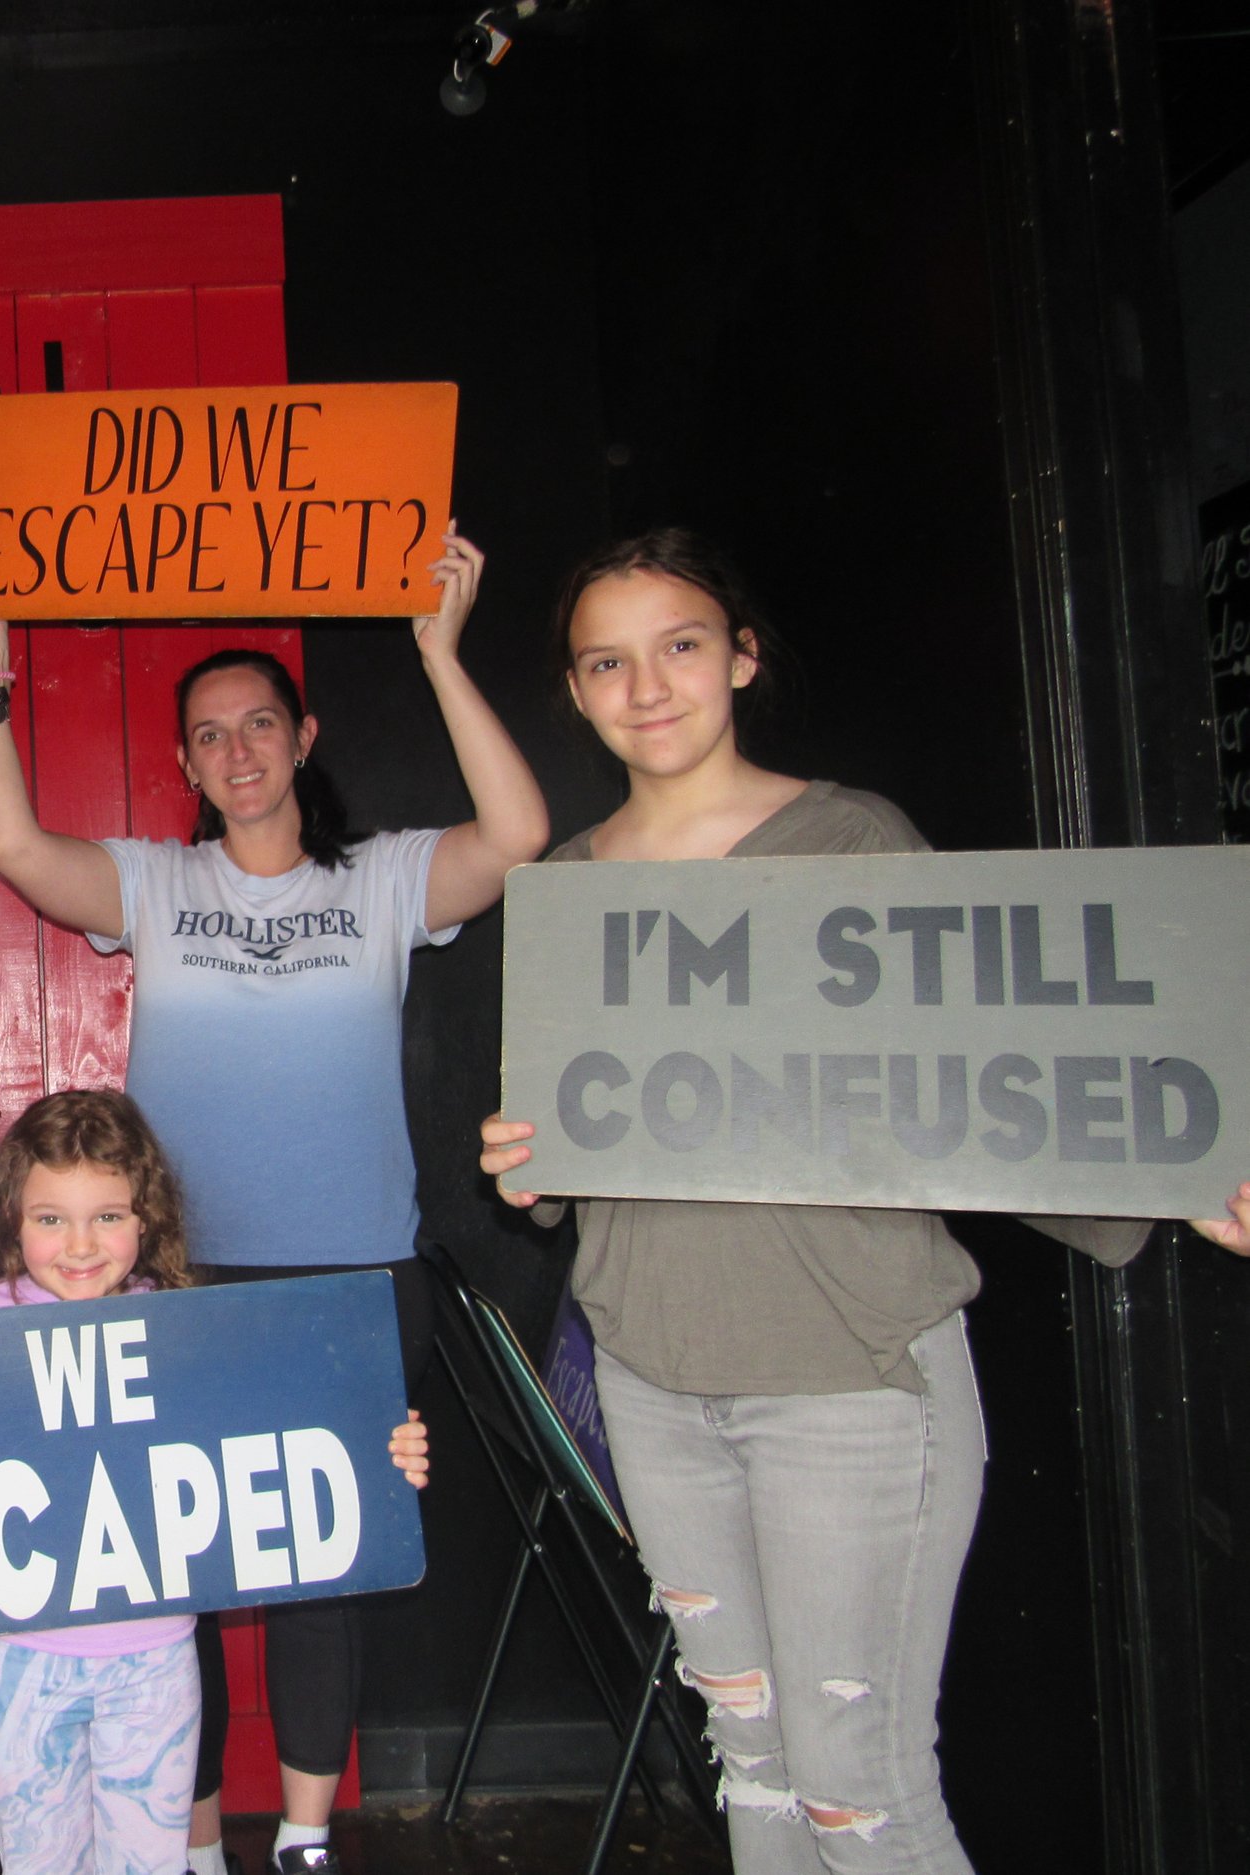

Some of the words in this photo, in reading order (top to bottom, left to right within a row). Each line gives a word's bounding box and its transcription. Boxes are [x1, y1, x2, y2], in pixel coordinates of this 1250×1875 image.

[84, 406, 185, 496] DID
[206, 403, 322, 493] WE
[252, 497, 429, 593] YET?
[171, 908, 363, 945] HOLLISTER
[181, 954, 258, 975] SOUTHERN
[263, 954, 350, 976] CALIFORNIA
[602, 908, 751, 1006] I'M
[816, 903, 1155, 1008] STILL
[556, 1050, 1220, 1165] CONFUSED
[24, 1319, 155, 1432] WE
